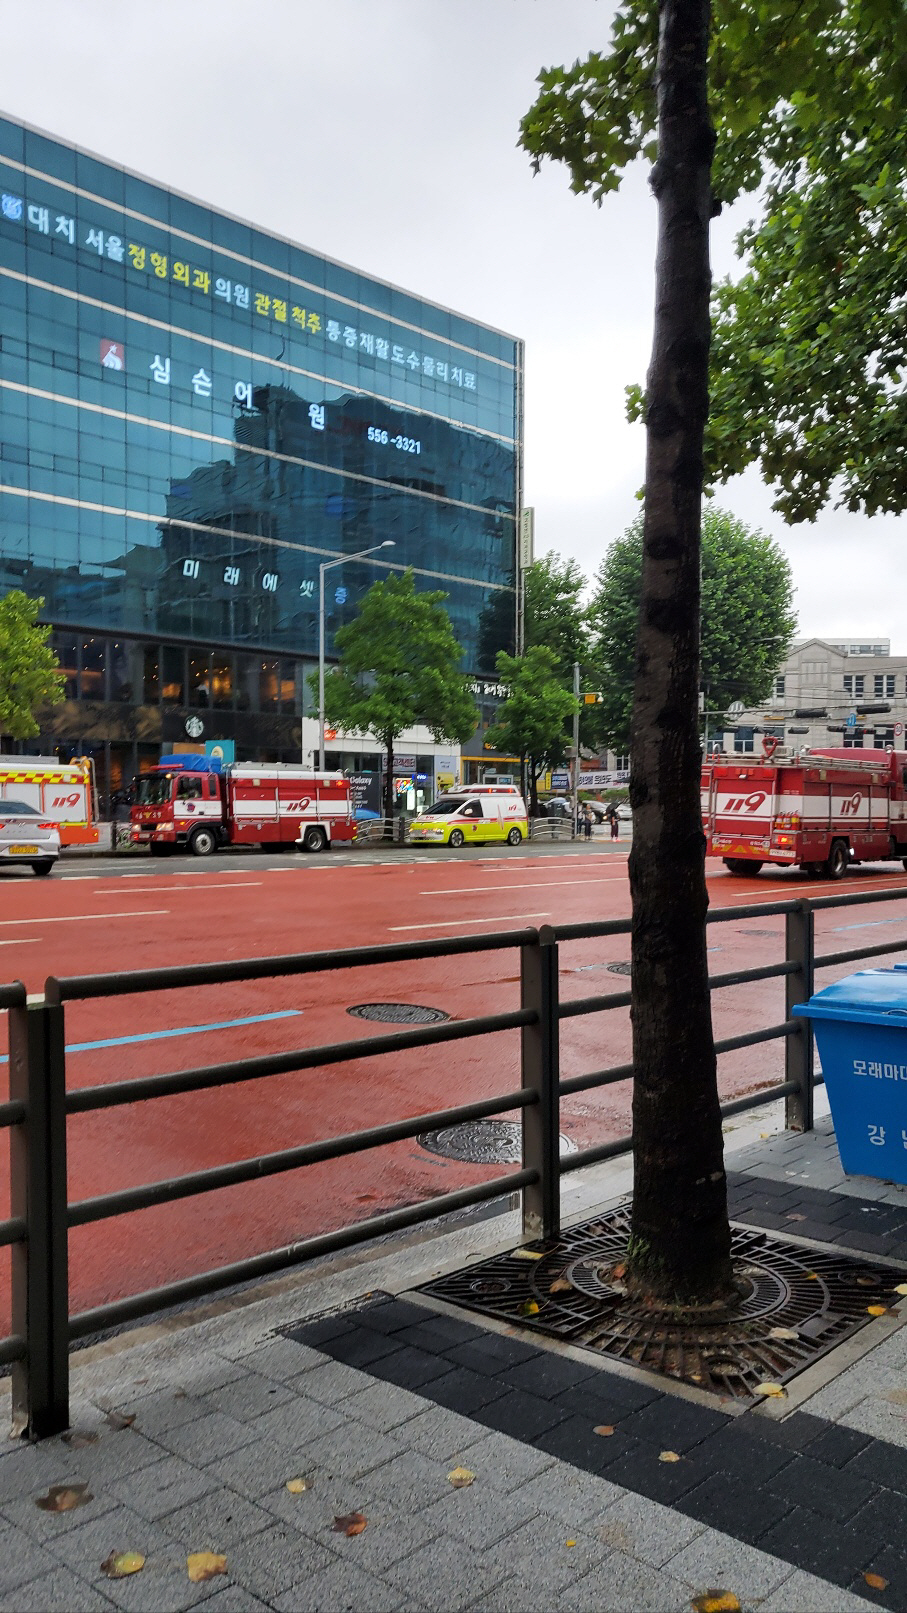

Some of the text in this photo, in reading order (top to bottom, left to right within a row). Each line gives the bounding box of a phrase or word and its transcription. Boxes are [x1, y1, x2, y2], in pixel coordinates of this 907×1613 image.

[51, 792, 80, 808] 119
[286, 796, 312, 812] 119
[722, 790, 768, 814] 119
[839, 791, 863, 815] 119
